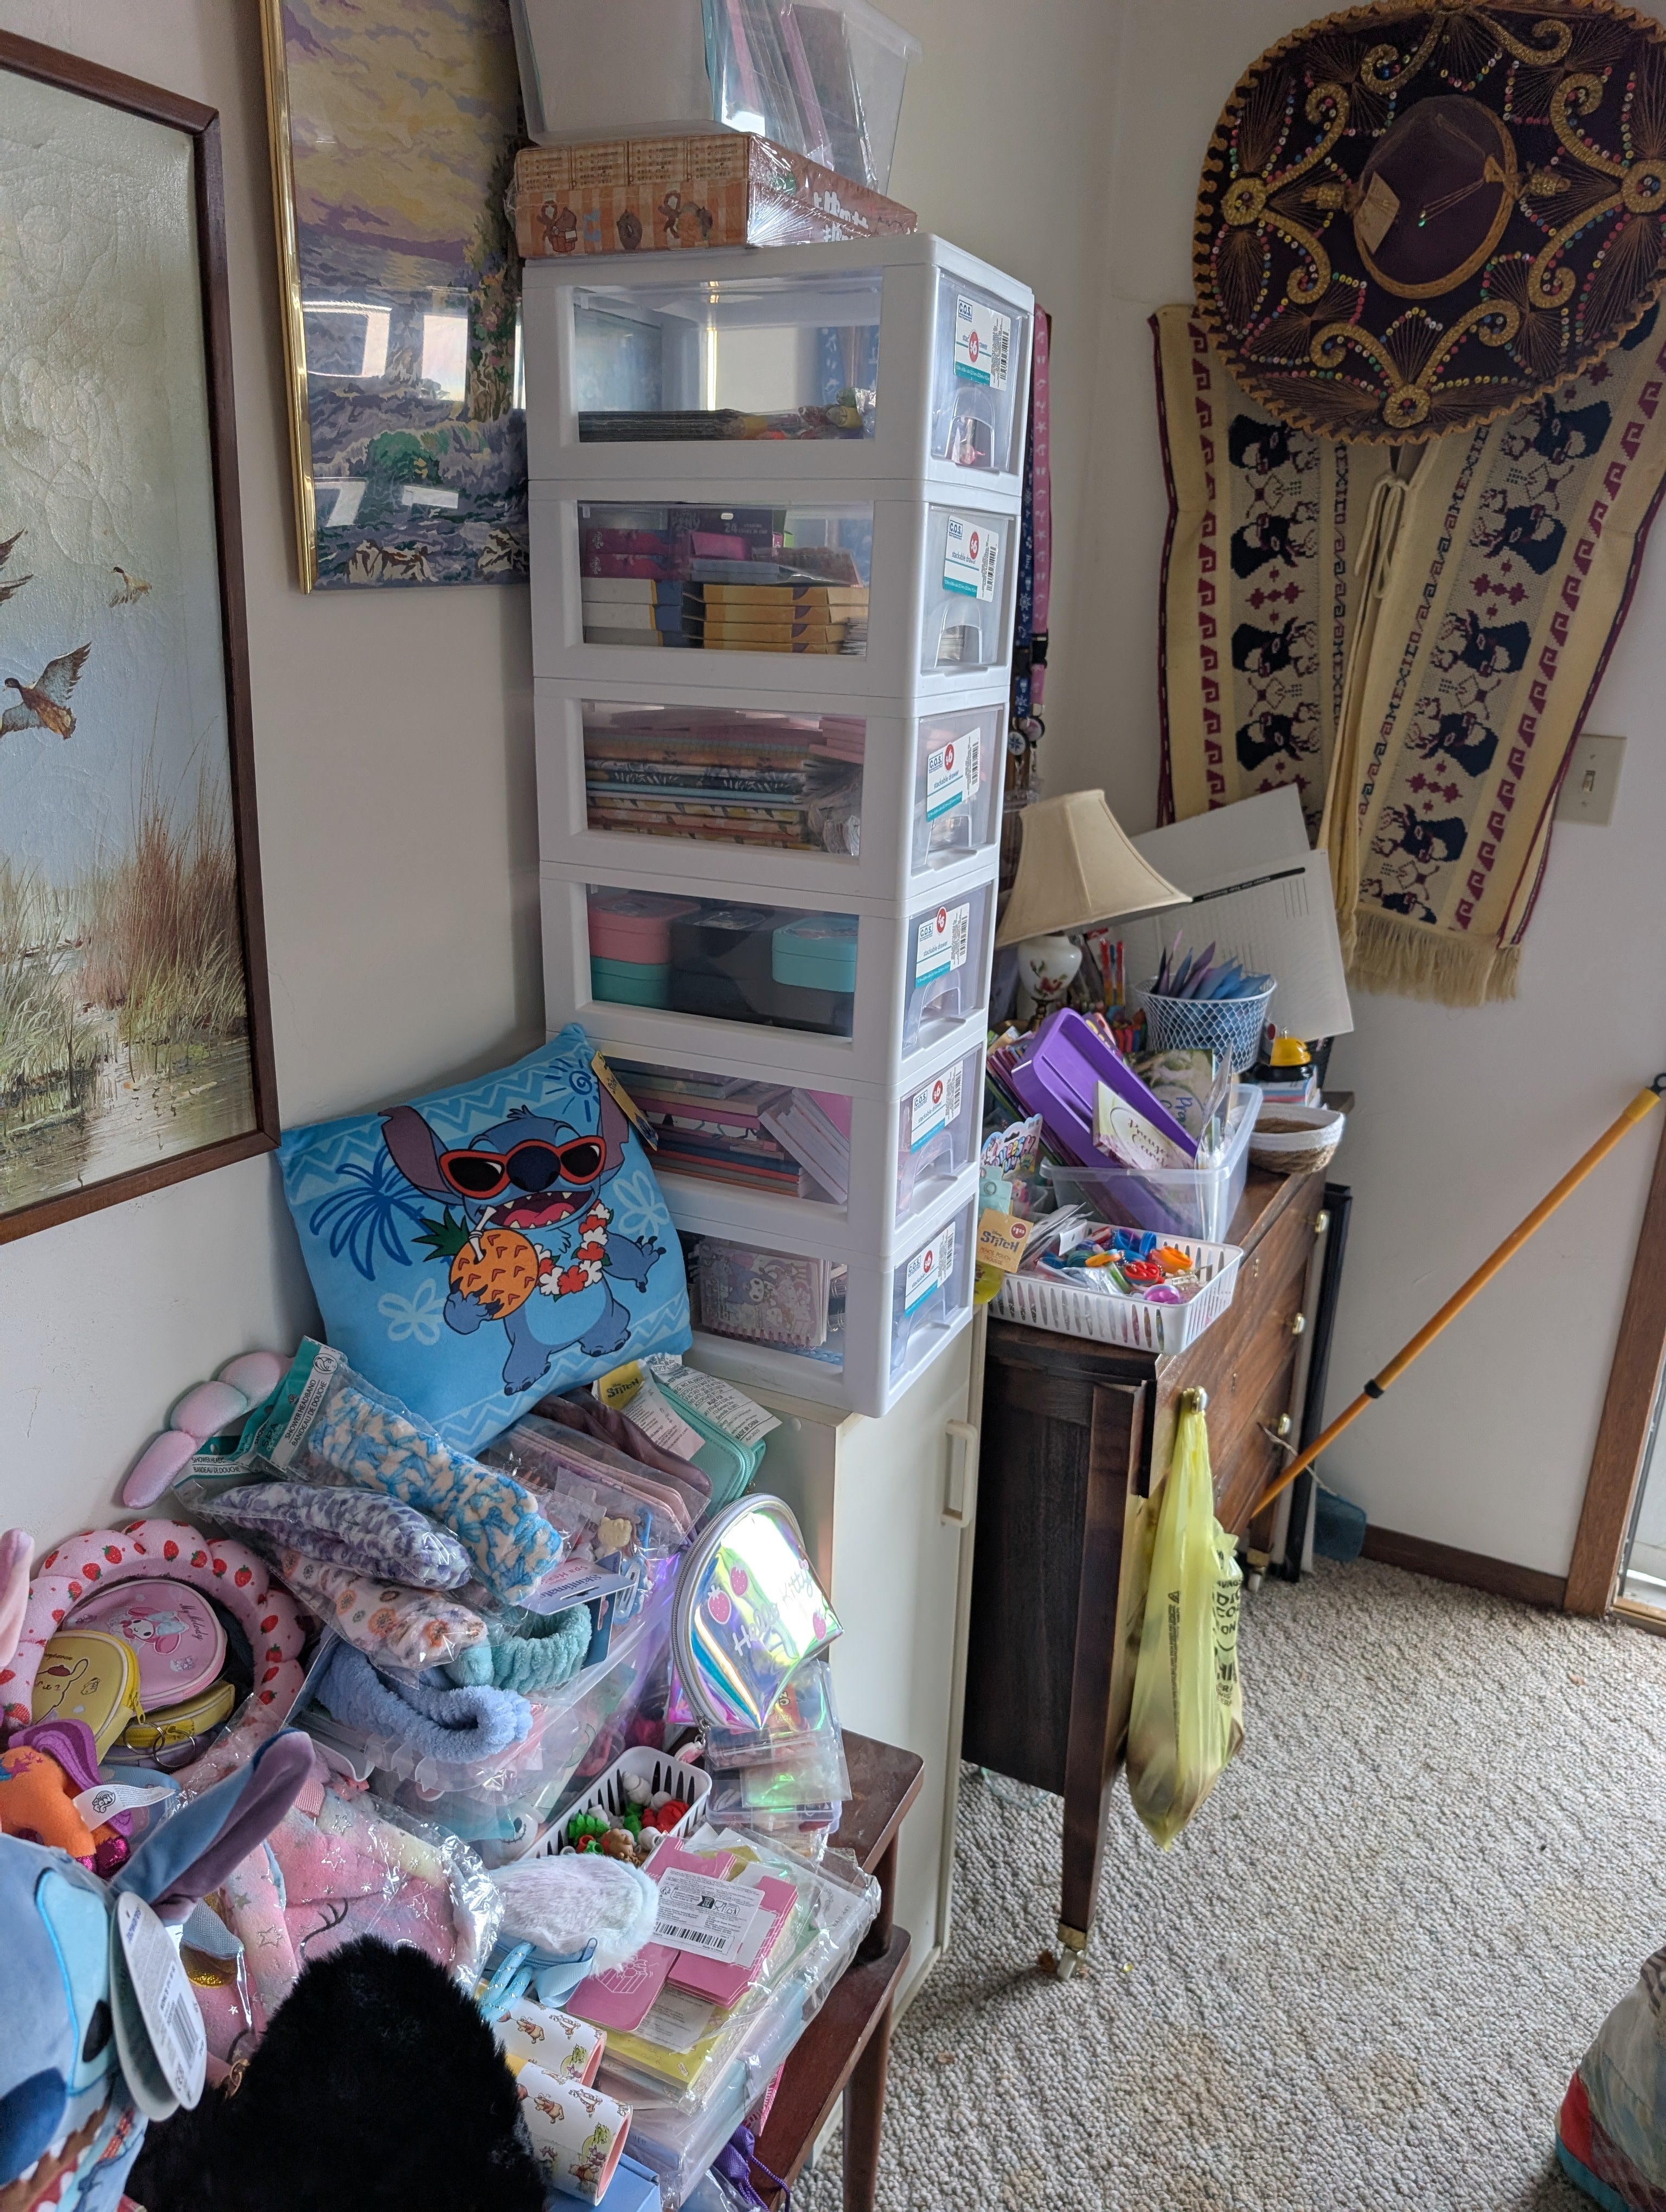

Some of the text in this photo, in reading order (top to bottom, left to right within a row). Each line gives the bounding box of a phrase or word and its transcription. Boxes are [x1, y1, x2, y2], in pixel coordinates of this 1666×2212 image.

[970, 340, 977, 356] $6
[970, 539, 977, 554] $6
[952, 551, 965, 561] stackable
[929, 756, 943, 769] C.O.S.
[945, 749, 953, 766] $6
[933, 770, 959, 789] stackable drawer
[938, 914, 945, 928] $6
[920, 925, 932, 937] C.O.S.
[923, 941, 948, 957] stackable drawer
[914, 1093, 926, 1107] C.O.S.
[933, 1085, 941, 1100] $6
[918, 1101, 942, 1123] stackable drawer
[984, 1255, 1003, 1265] TROUSSE
[996, 1251, 1011, 1262] POUCH
[707, 1397, 717, 1406] MADE
[708, 1401, 721, 1412] FRANCO
[285, 1379, 316, 1440] SHOWER HEADBAND
[292, 1381, 327, 1446] BANDEAU DE DOUCHE
[261, 1423, 279, 1448] SPA
[735, 1428, 747, 1440] MADE
[748, 1418, 760, 1429] CHINA
[568, 1565, 588, 1574] Spa
[179, 1603, 210, 1642] My Melody
[733, 1603, 780, 1656] Hello
